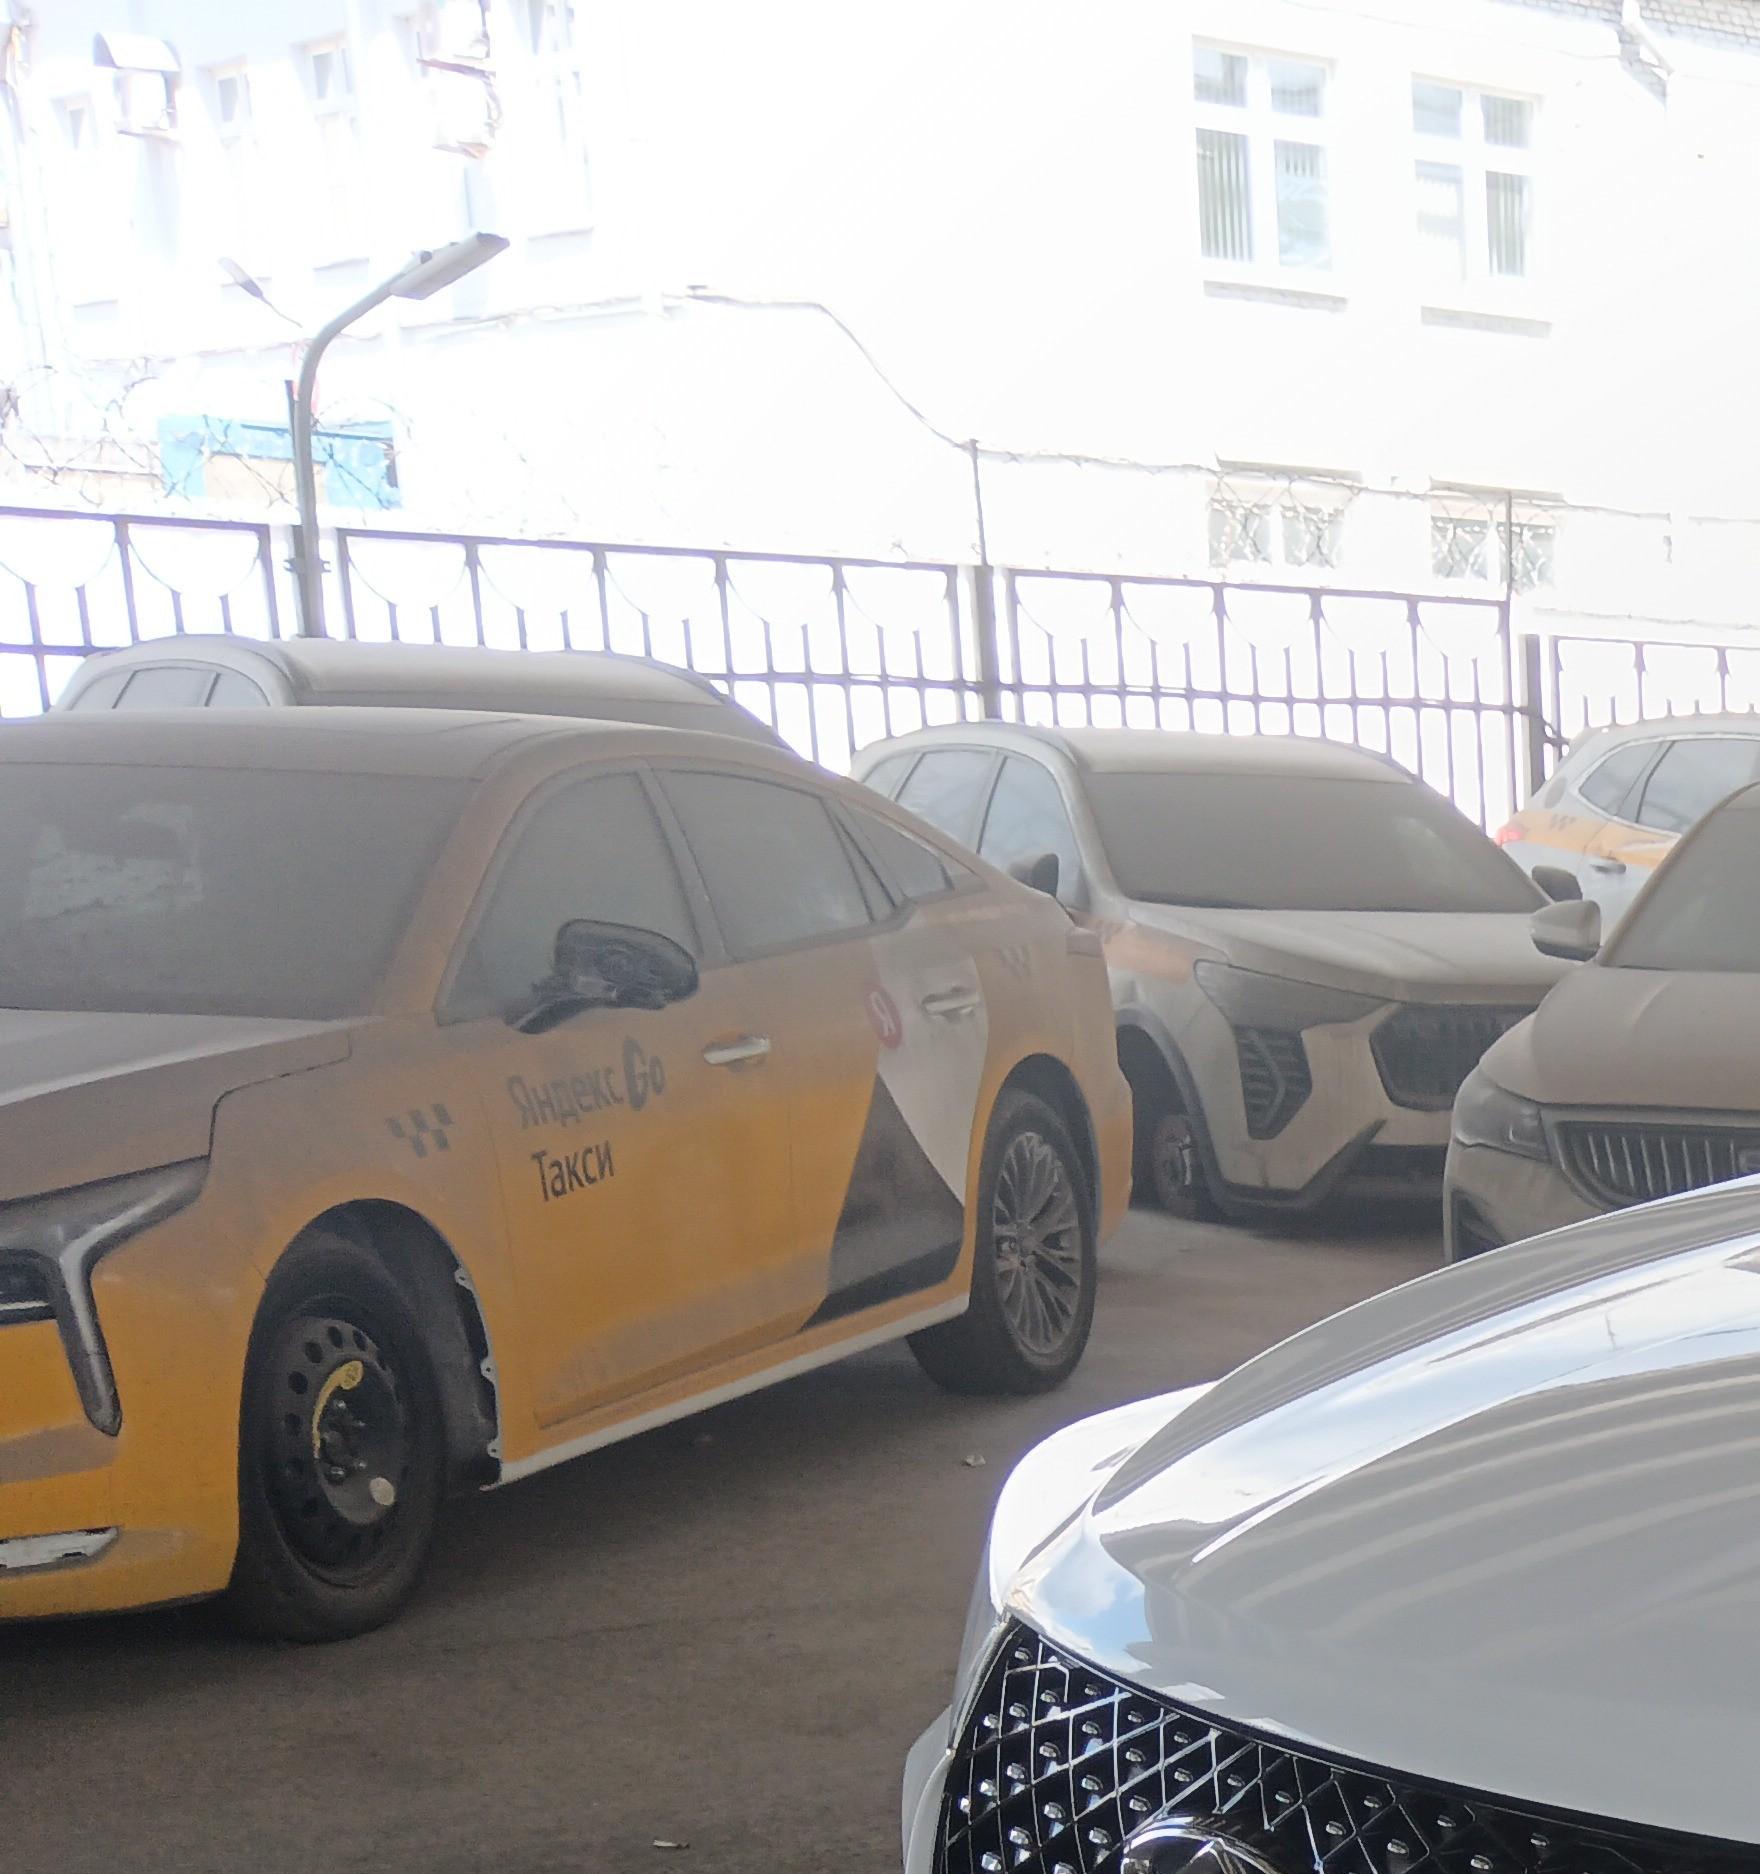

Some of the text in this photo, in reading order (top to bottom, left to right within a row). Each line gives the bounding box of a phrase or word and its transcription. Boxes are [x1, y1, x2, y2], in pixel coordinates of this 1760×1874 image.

[507, 1036, 666, 1129] Яндекс Go
[531, 1139, 615, 1201] Такси
